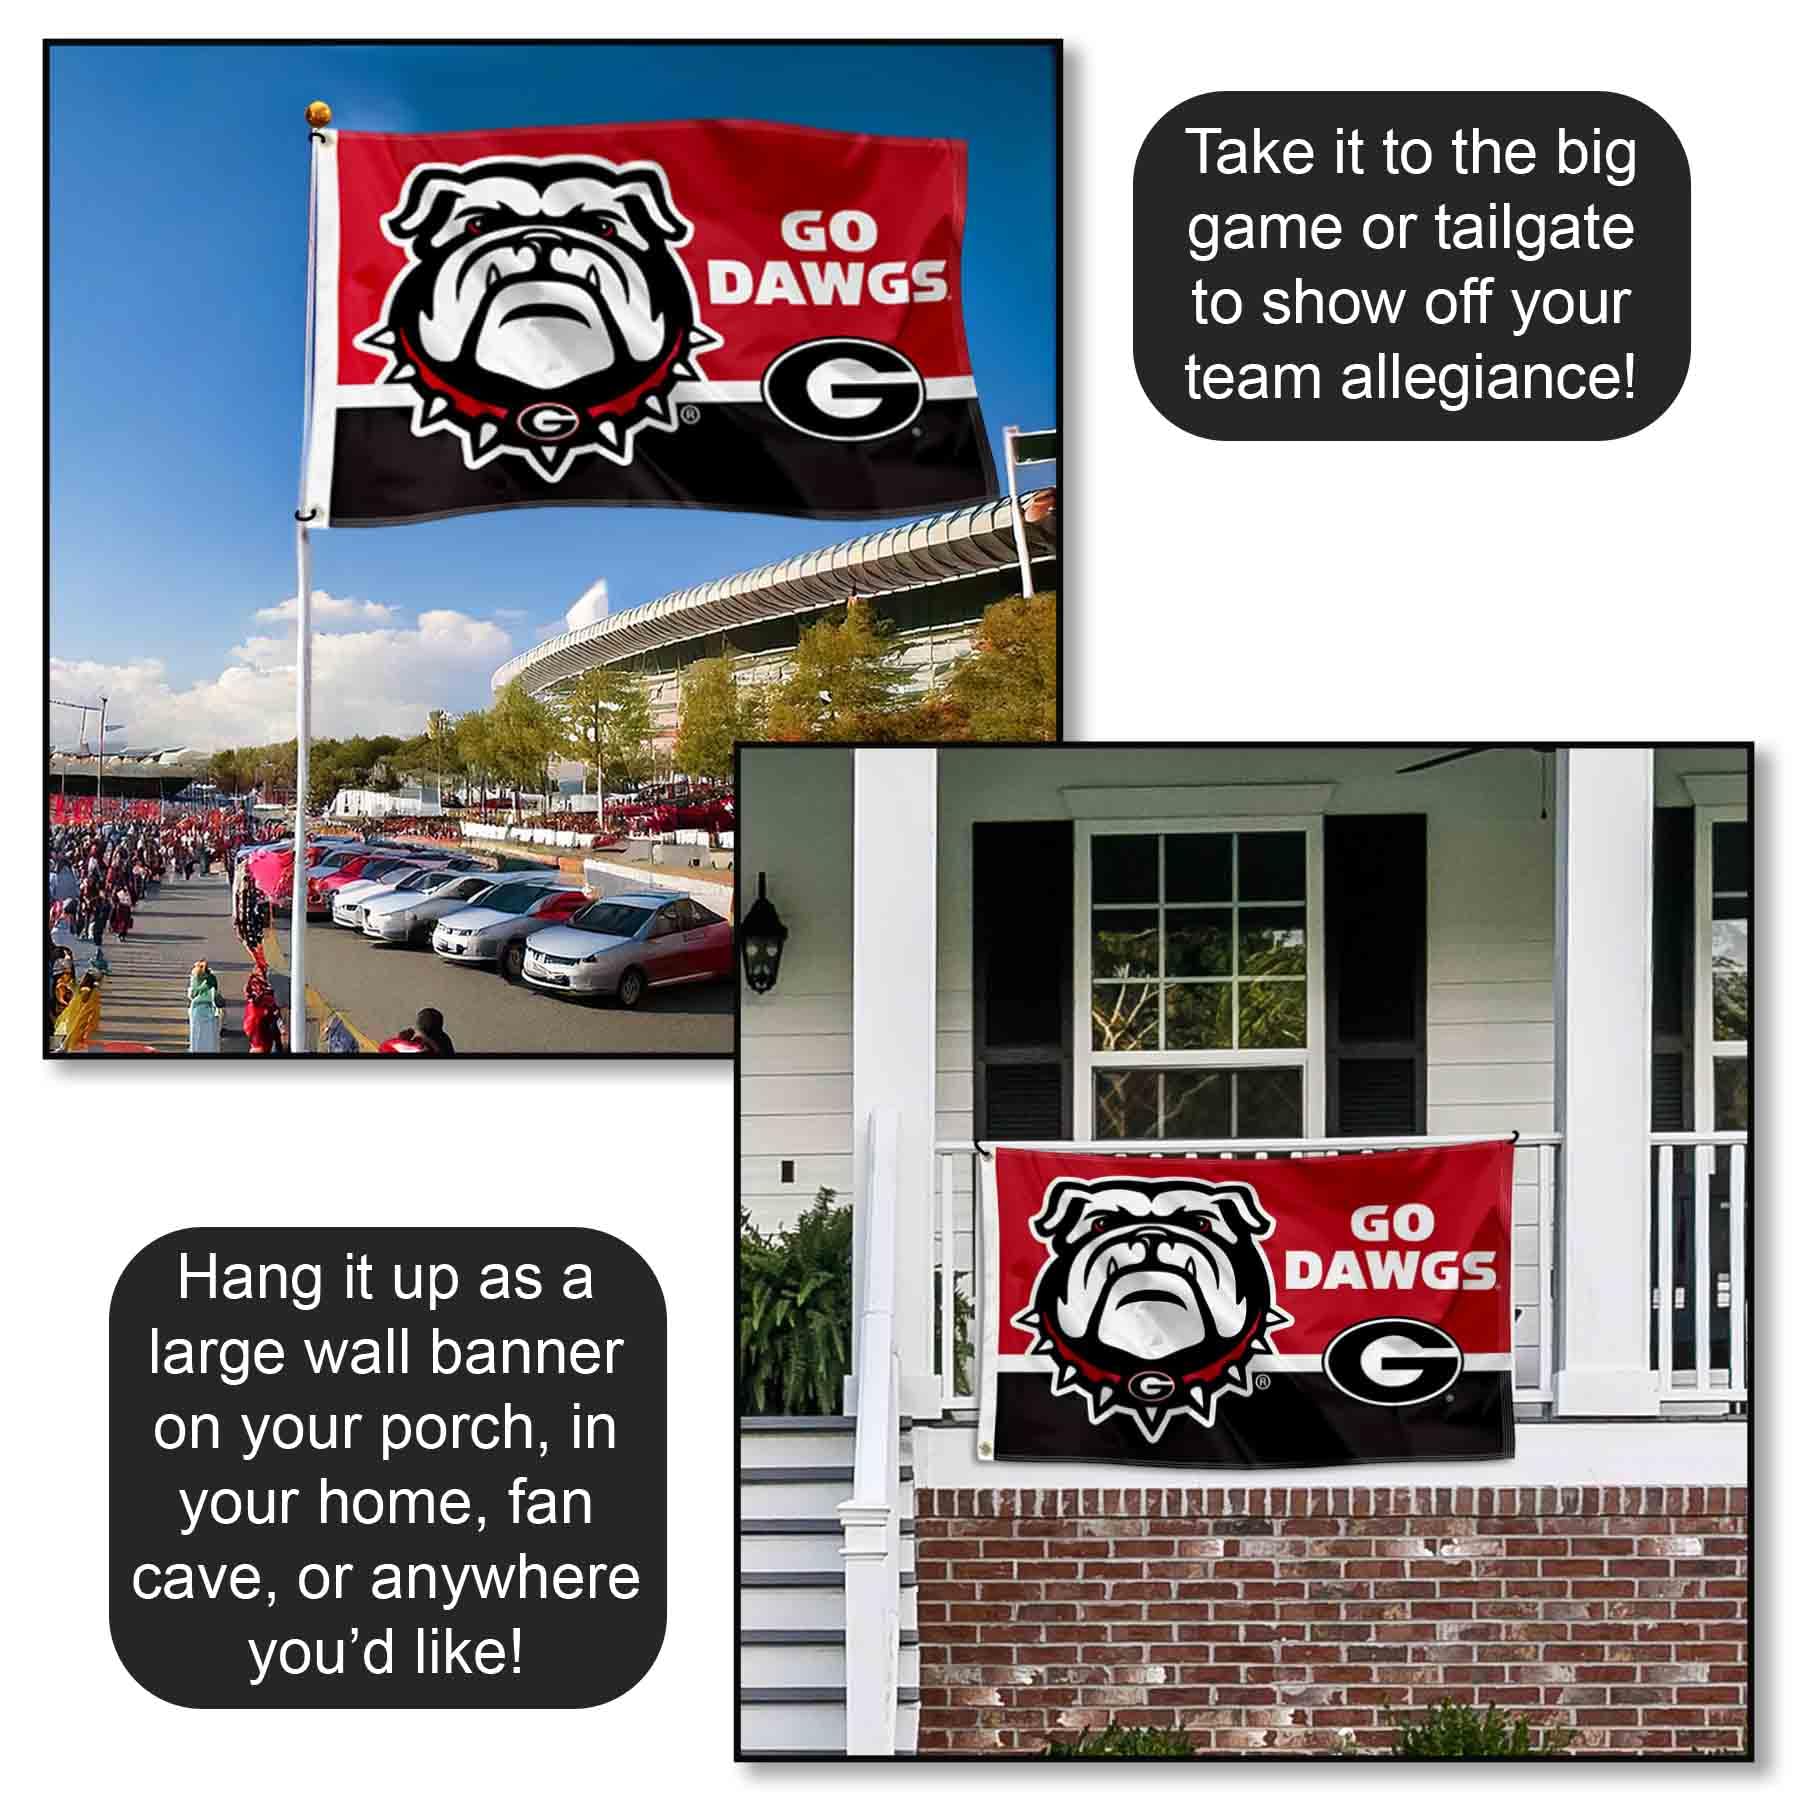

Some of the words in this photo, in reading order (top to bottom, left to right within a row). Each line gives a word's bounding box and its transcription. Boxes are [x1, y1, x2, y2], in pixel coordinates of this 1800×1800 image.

[781, 209, 878, 253] GO
[708, 259, 948, 306] DAWGS
[1350, 1203, 1435, 1242] GO
[1286, 1250, 1497, 1290] DAWGS
